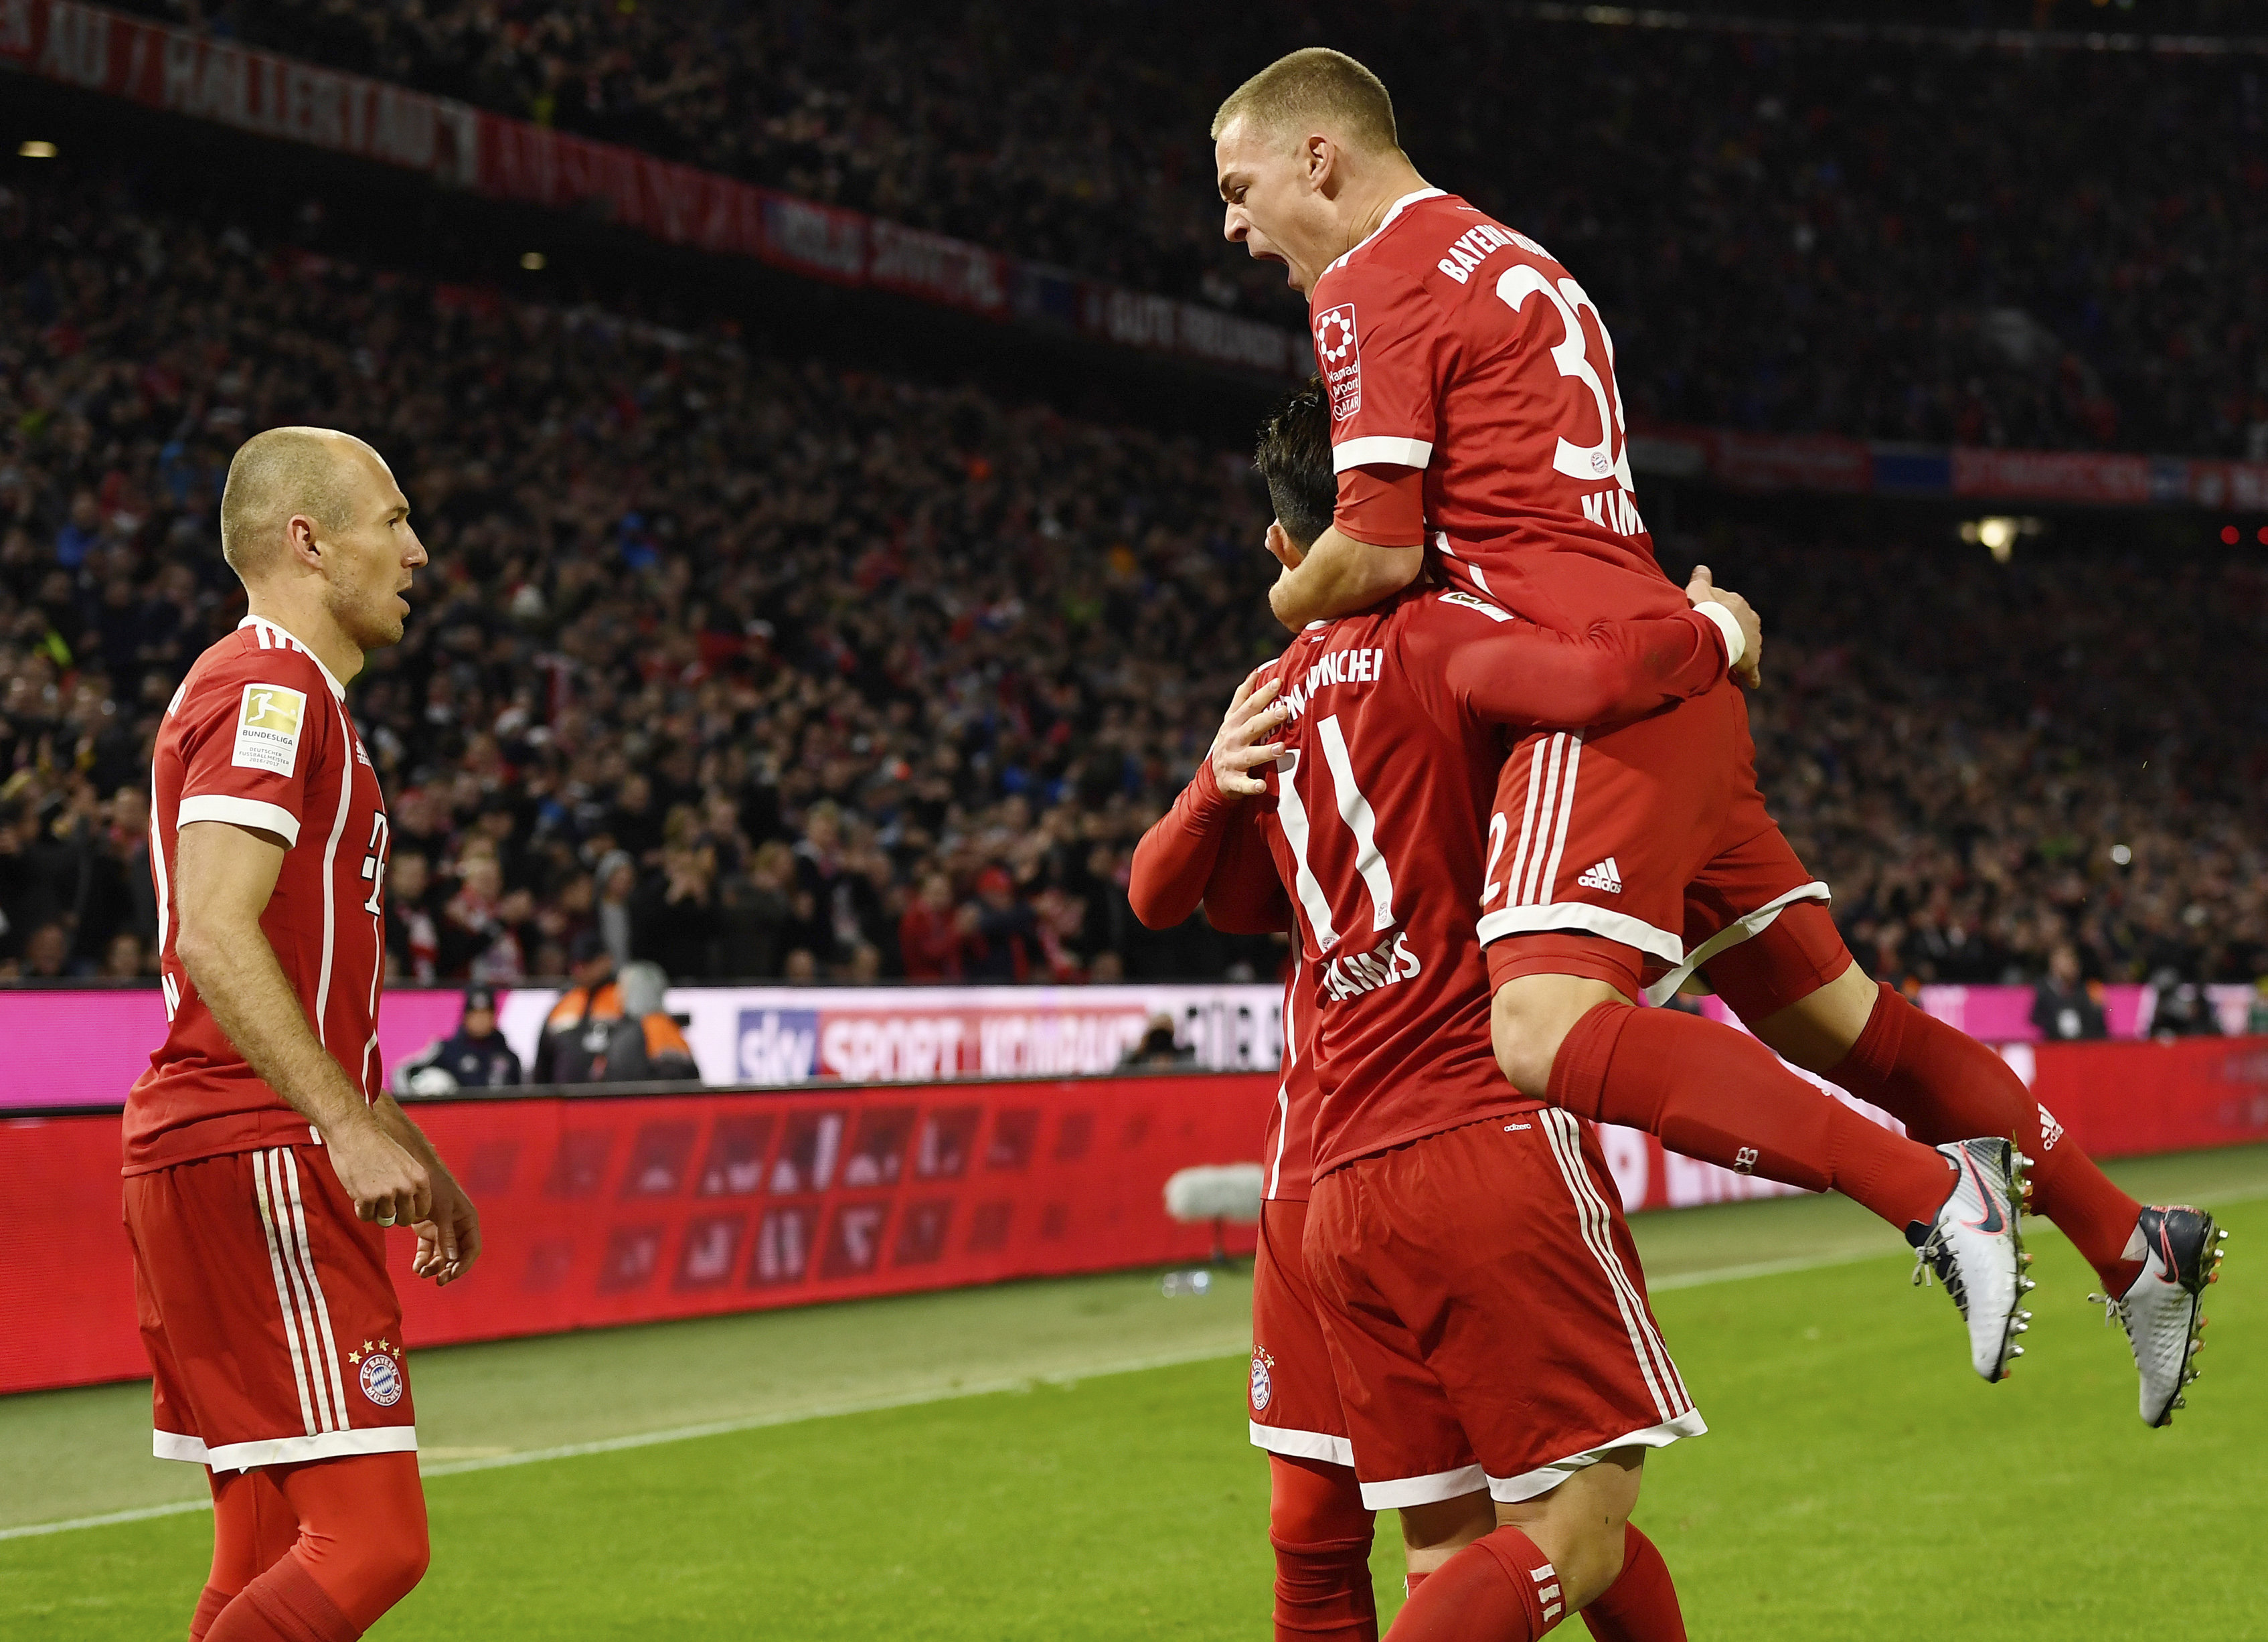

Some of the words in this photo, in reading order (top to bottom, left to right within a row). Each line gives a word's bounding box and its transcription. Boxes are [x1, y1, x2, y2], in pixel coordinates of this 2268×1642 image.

[1437, 224, 1514, 284] BAYERN
[1328, 360, 1358, 382] Hamad
[1333, 377, 1358, 398] Airport
[1333, 396, 1360, 416] QATAR
[1581, 487, 1647, 537] KIM
[242, 730, 293, 746] BUNDESLIGA
[239, 751, 289, 765] FUSSBALLMEISTER
[249, 757, 279, 766] 2016/2017
[250, 747, 282, 756] DEUTSCHER
[1577, 876, 1623, 894] adidas
[1320, 931, 1421, 1001] JAMES
[823, 1017, 964, 1083] SPORT
[363, 1367, 372, 1379] FC
[369, 1357, 398, 1376] BAYERN
